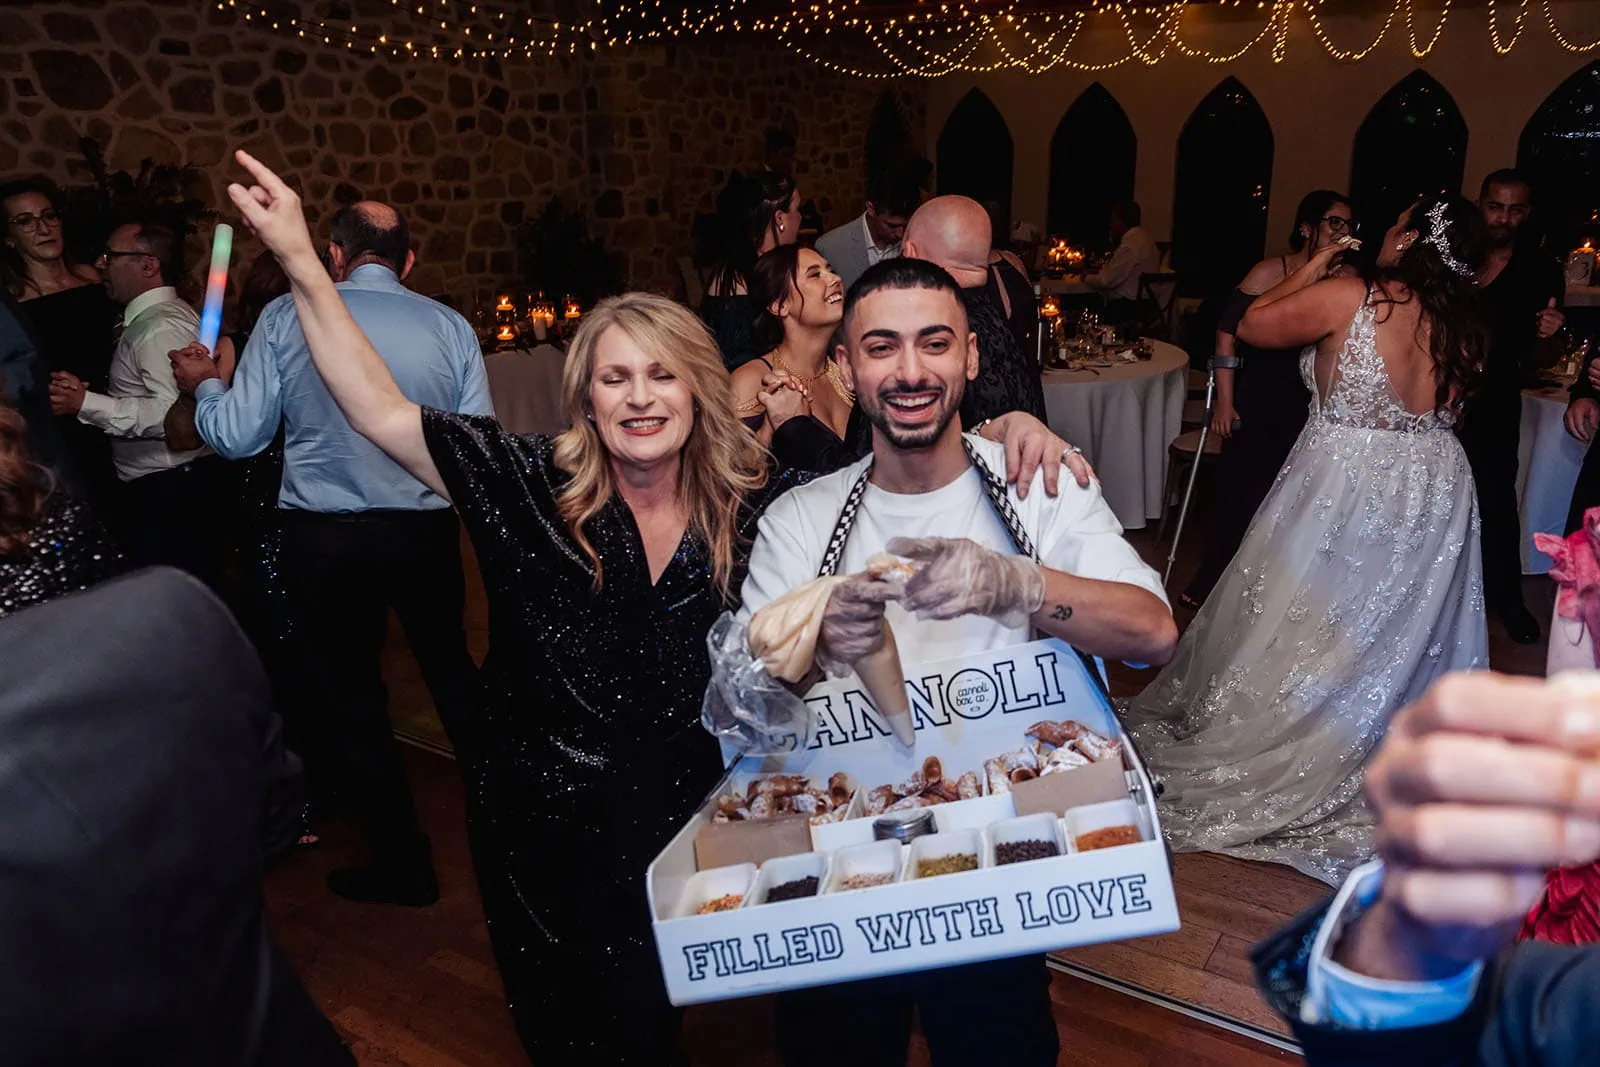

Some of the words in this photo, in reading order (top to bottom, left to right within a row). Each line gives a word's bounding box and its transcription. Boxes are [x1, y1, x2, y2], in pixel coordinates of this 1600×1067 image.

[1048, 604, 1074, 622] 29
[955, 696, 974, 707] box
[682, 922, 844, 982] FILLED
[856, 896, 1004, 953] WITH
[1016, 873, 1153, 930] LOVE
